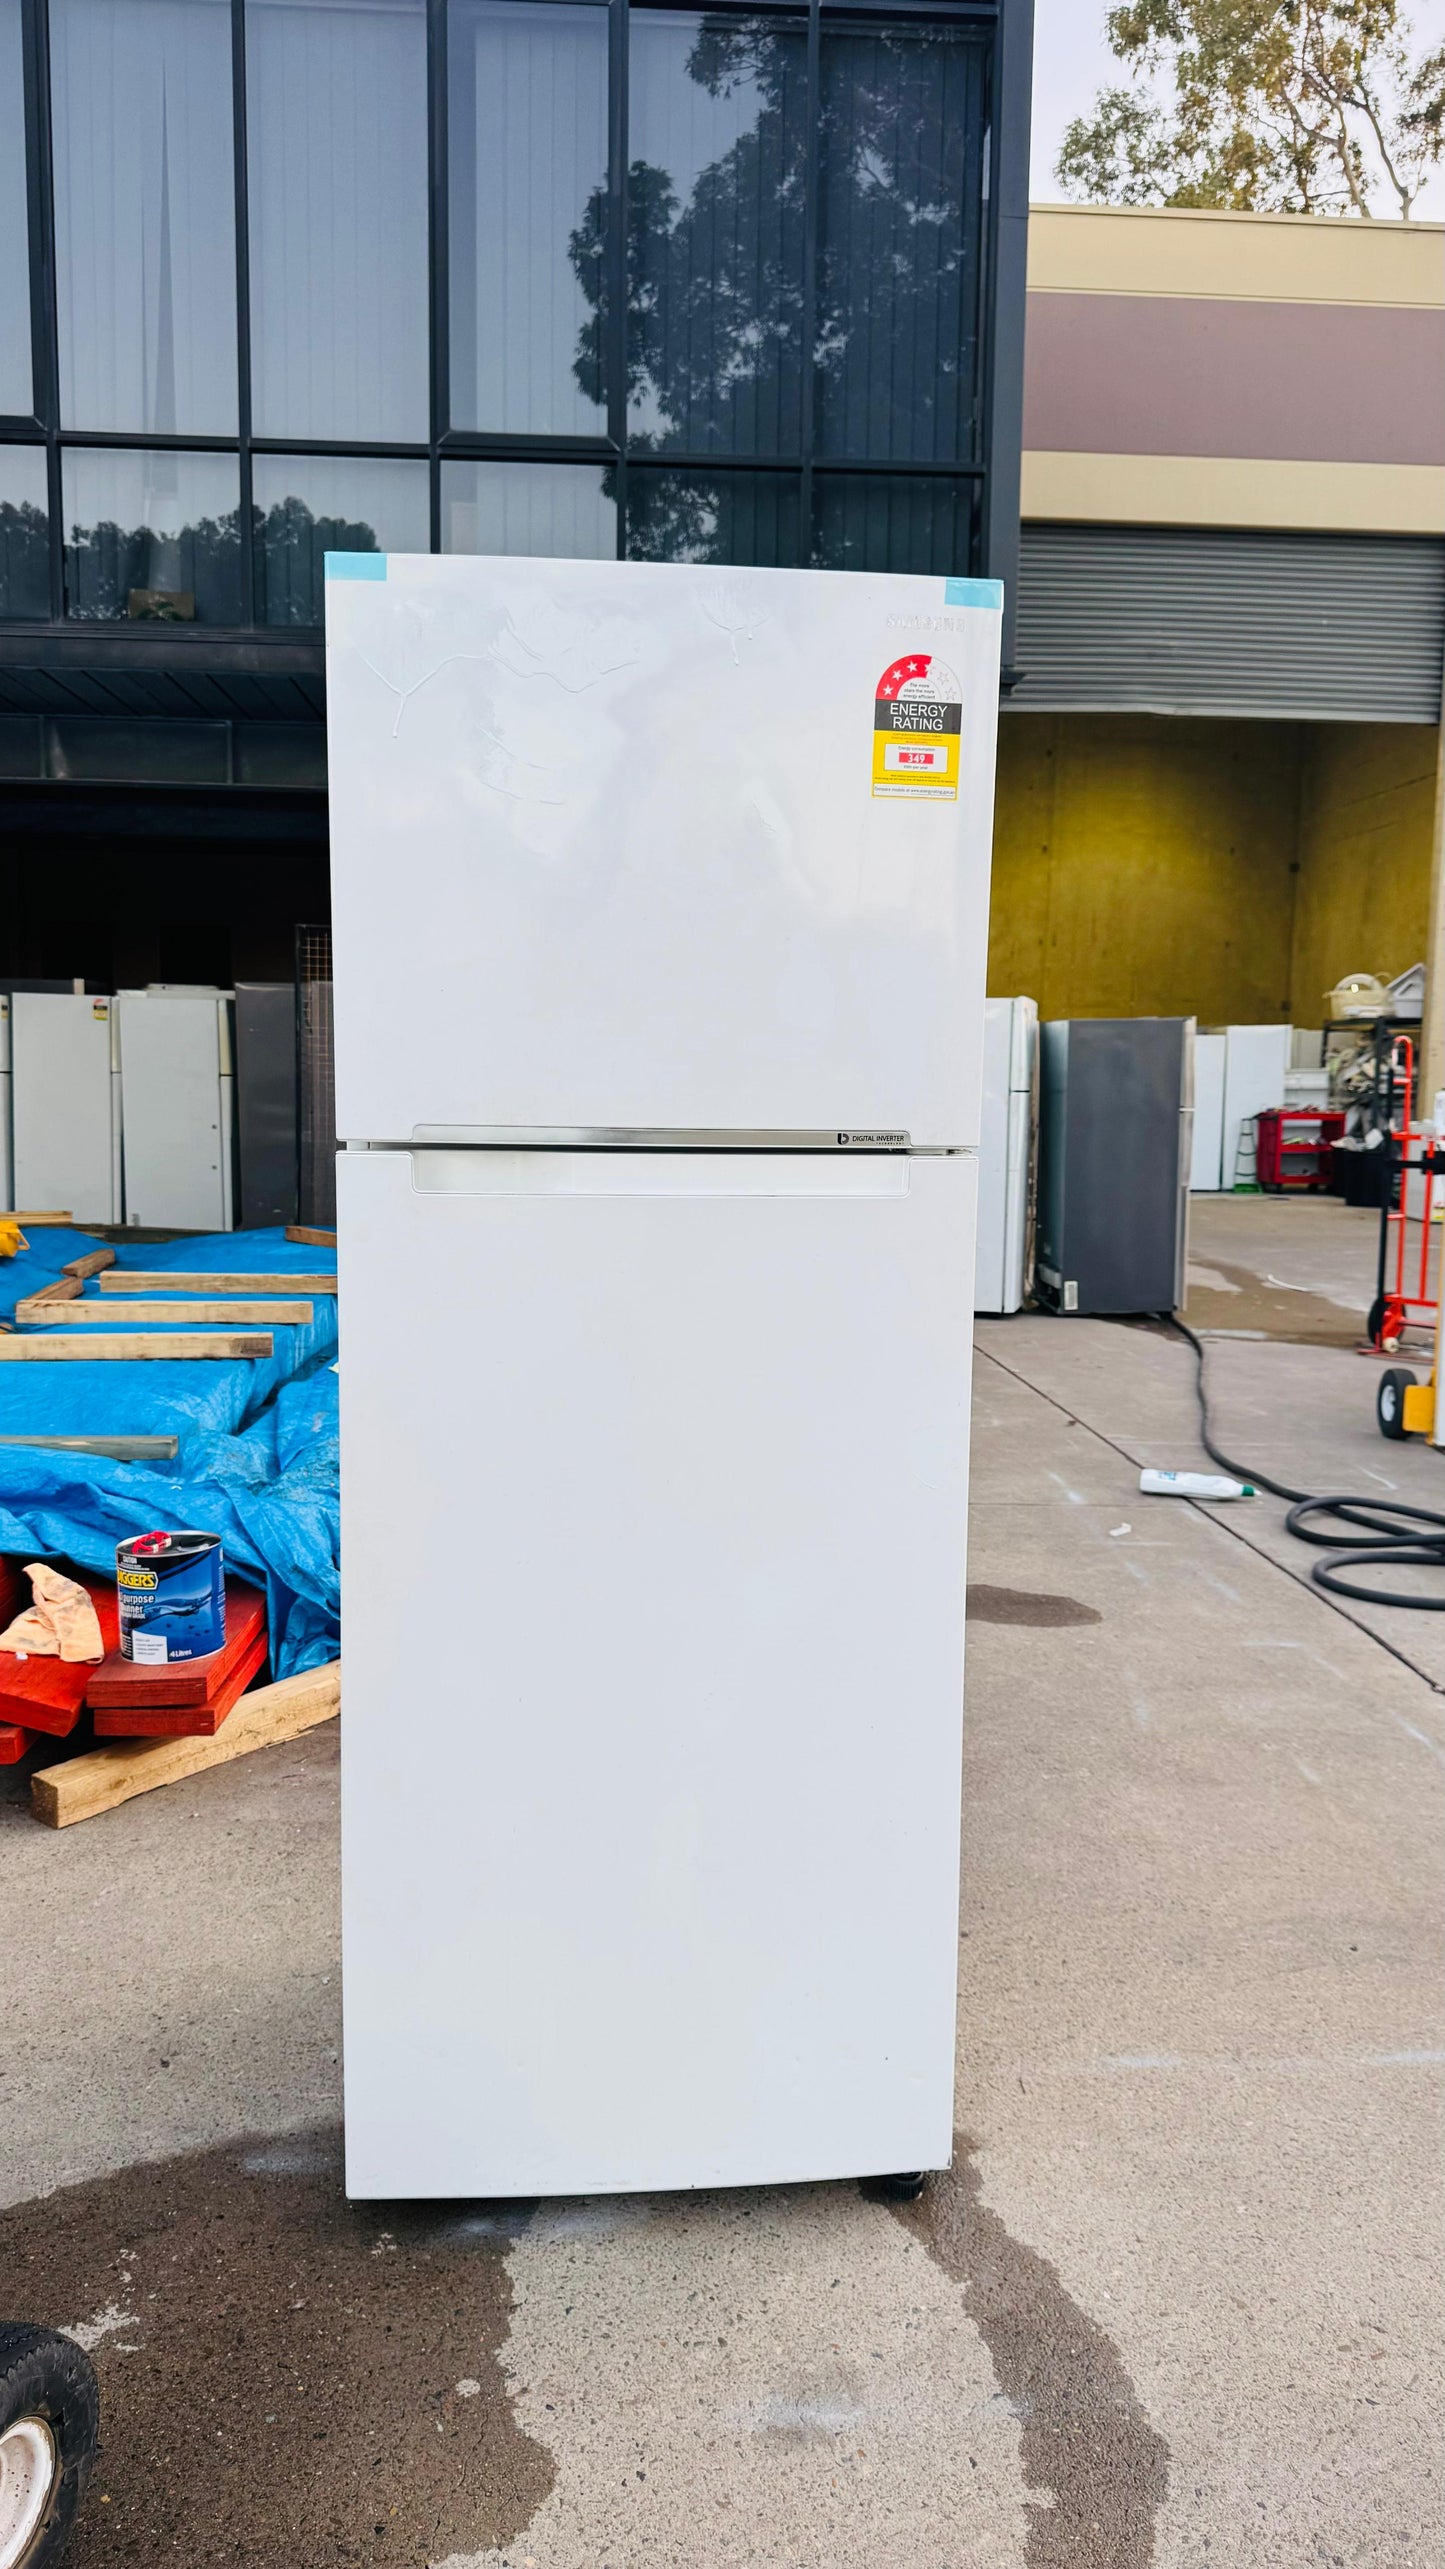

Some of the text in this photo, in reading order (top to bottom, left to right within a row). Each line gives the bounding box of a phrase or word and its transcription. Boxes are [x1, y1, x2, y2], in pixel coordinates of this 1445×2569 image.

[890, 702, 948, 718] ENERGY
[892, 716, 944, 731] RATING
[907, 753, 926, 764] 349
